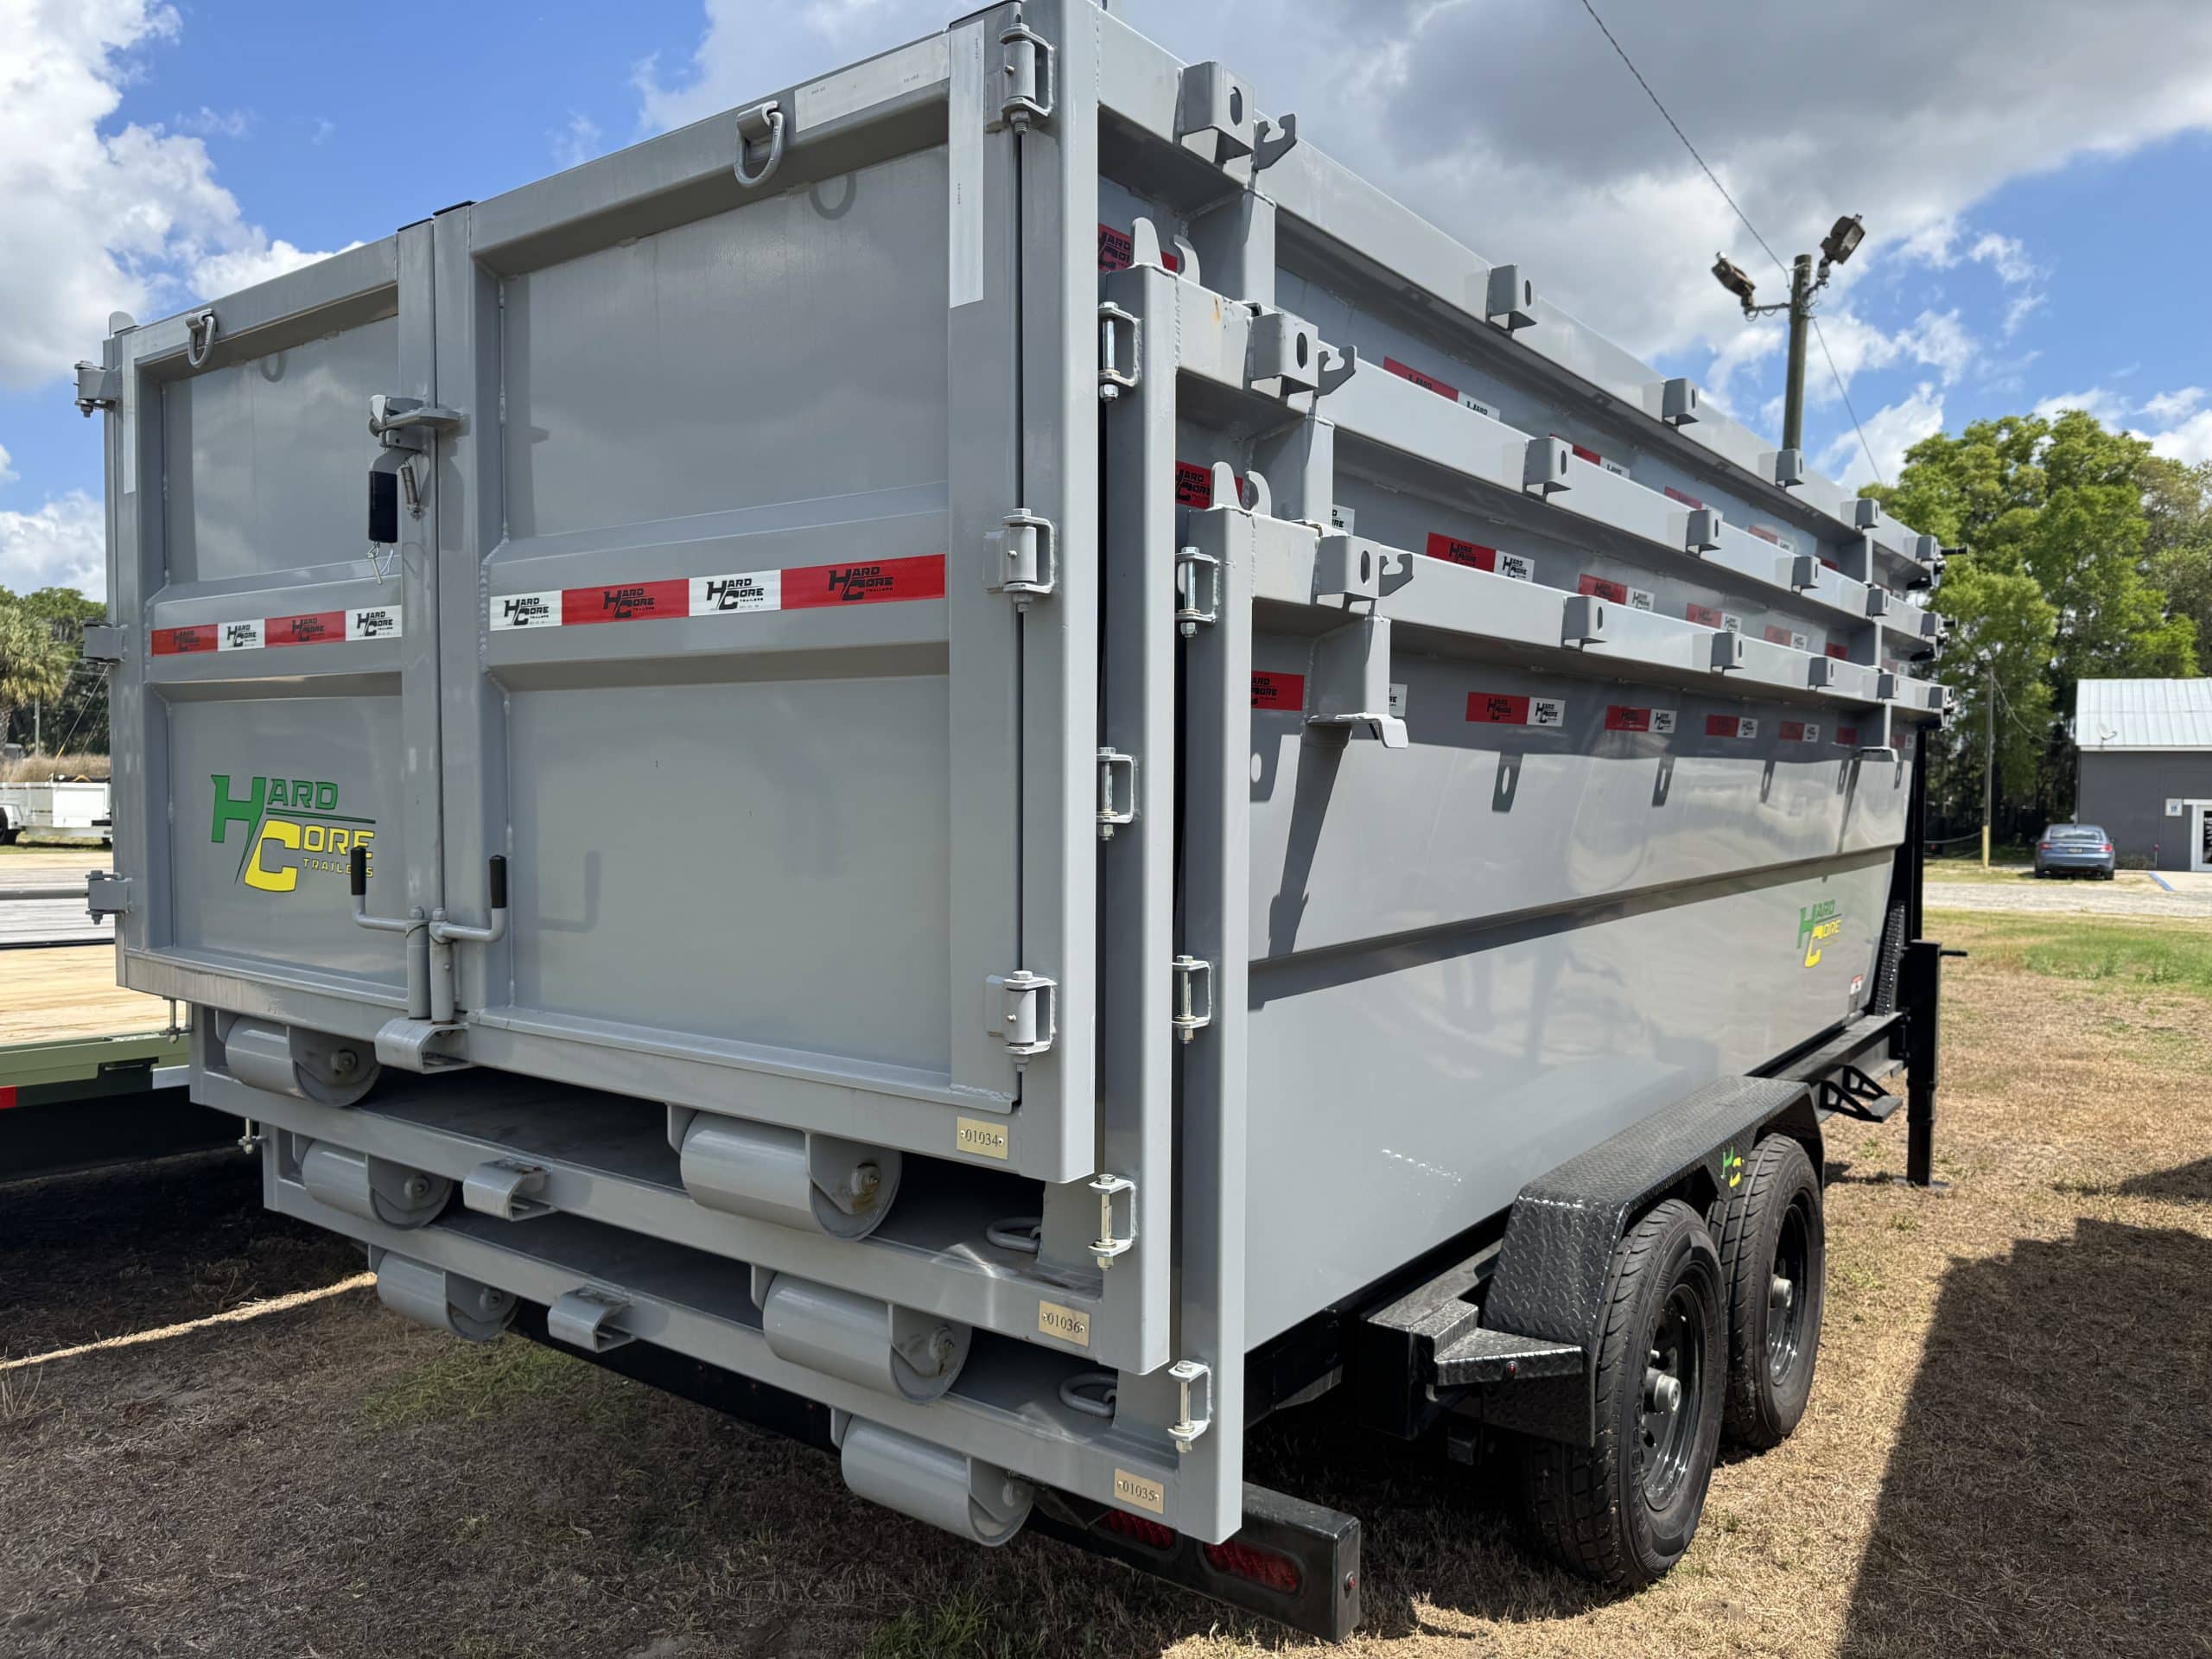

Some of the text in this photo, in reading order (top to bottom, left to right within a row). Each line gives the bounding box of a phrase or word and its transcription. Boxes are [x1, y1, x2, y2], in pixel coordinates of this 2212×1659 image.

[706, 578, 753, 605] HARD
[828, 567, 880, 595] HARD
[842, 576, 893, 601] CORE
[504, 597, 540, 620] HARD
[603, 588, 644, 614] HARD
[614, 597, 655, 619] CORE
[719, 588, 765, 610] CORE
[357, 611, 385, 632] HARD
[513, 606, 550, 626] CORE
[365, 619, 393, 637] CORE
[211, 774, 339, 883] HARD
[245, 819, 375, 893] CORE
[303, 857, 374, 878] TRAILES
[965, 1128, 999, 1147] 01034
[1047, 1313, 1081, 1334] 01036
[1122, 1480, 1155, 1502] 01035
